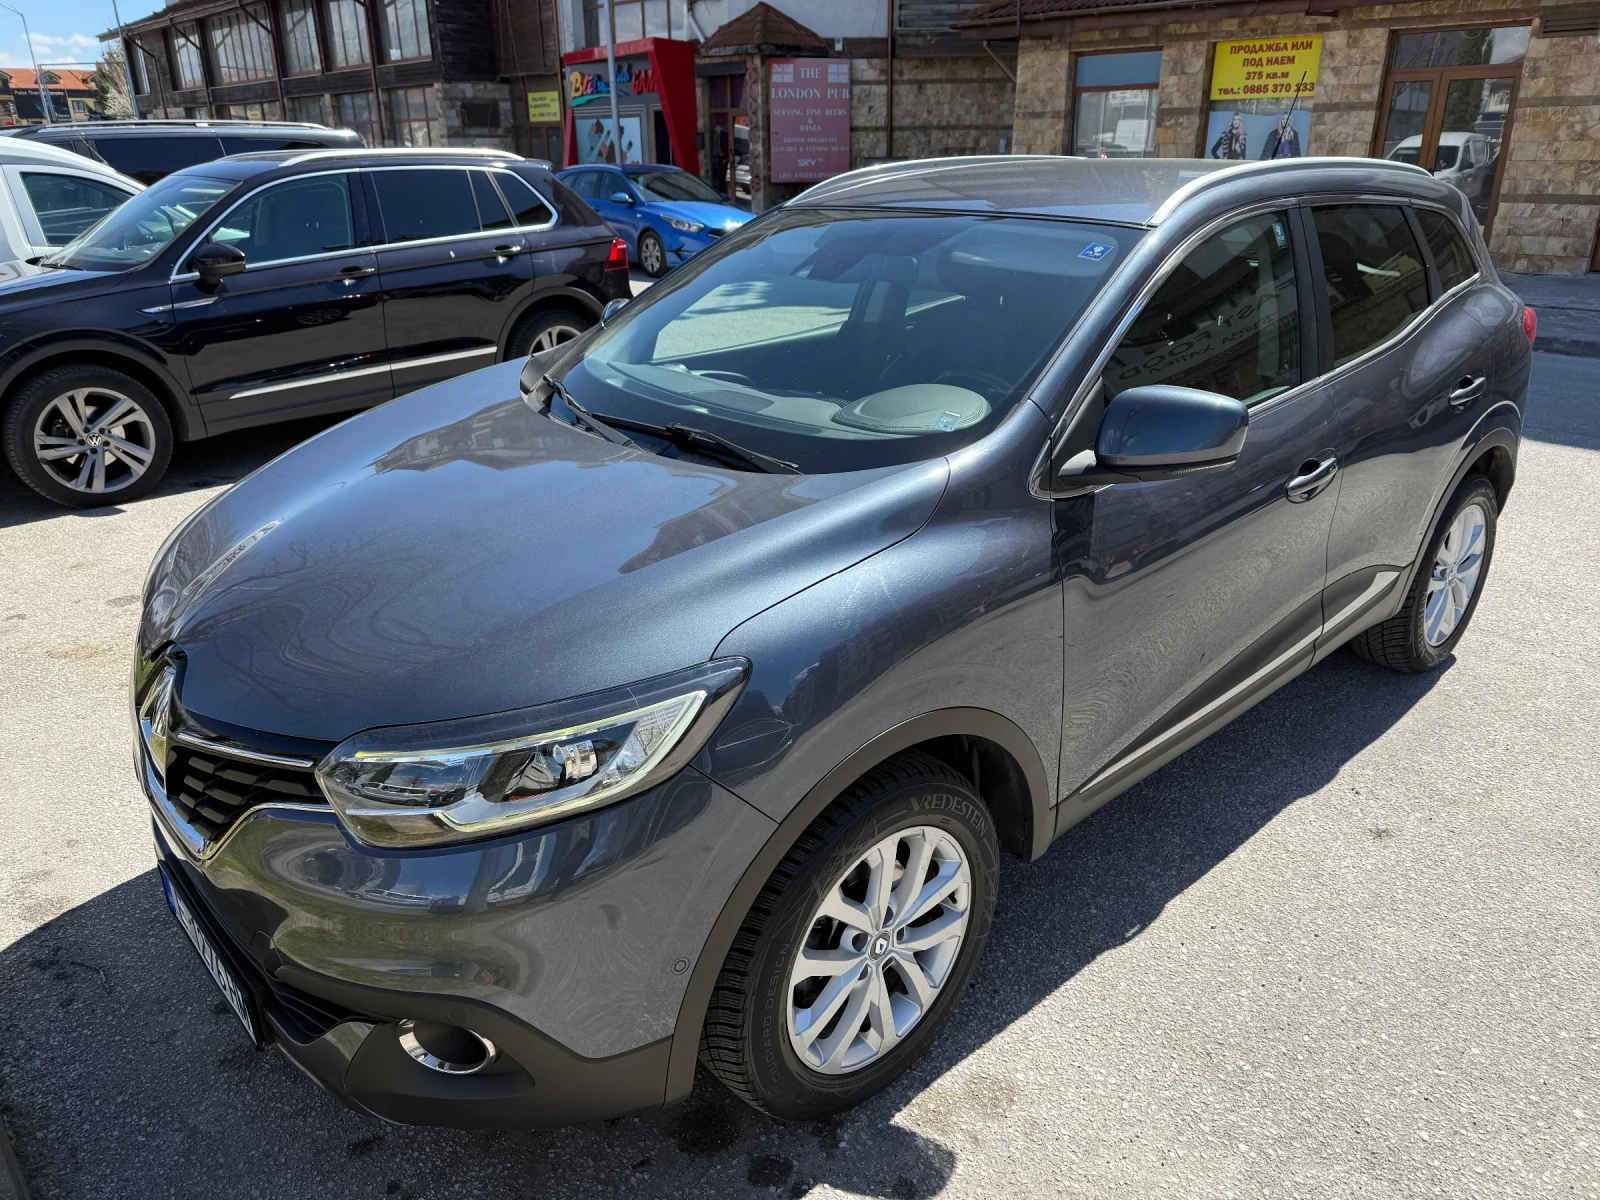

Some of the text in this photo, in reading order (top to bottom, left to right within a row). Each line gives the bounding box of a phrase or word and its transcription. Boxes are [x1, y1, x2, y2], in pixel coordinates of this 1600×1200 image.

[1229, 40, 1314, 55] ПРОДАЖБА ИЛИ
[1242, 55, 1296, 68] ПОД НАЕМ
[799, 67, 822, 79] THE
[1245, 71, 1264, 80] 375
[632, 68, 659, 95] GAM
[771, 87, 850, 99] LONDON PUB
[1243, 84, 1269, 94] 0885
[1271, 83, 1292, 93] 370
[773, 108, 847, 116] SERVING FINE BEERS
[797, 159, 816, 167] SKY
[910, 794, 988, 836] VREDESTEIN
[765, 943, 790, 1010] DESIGN
